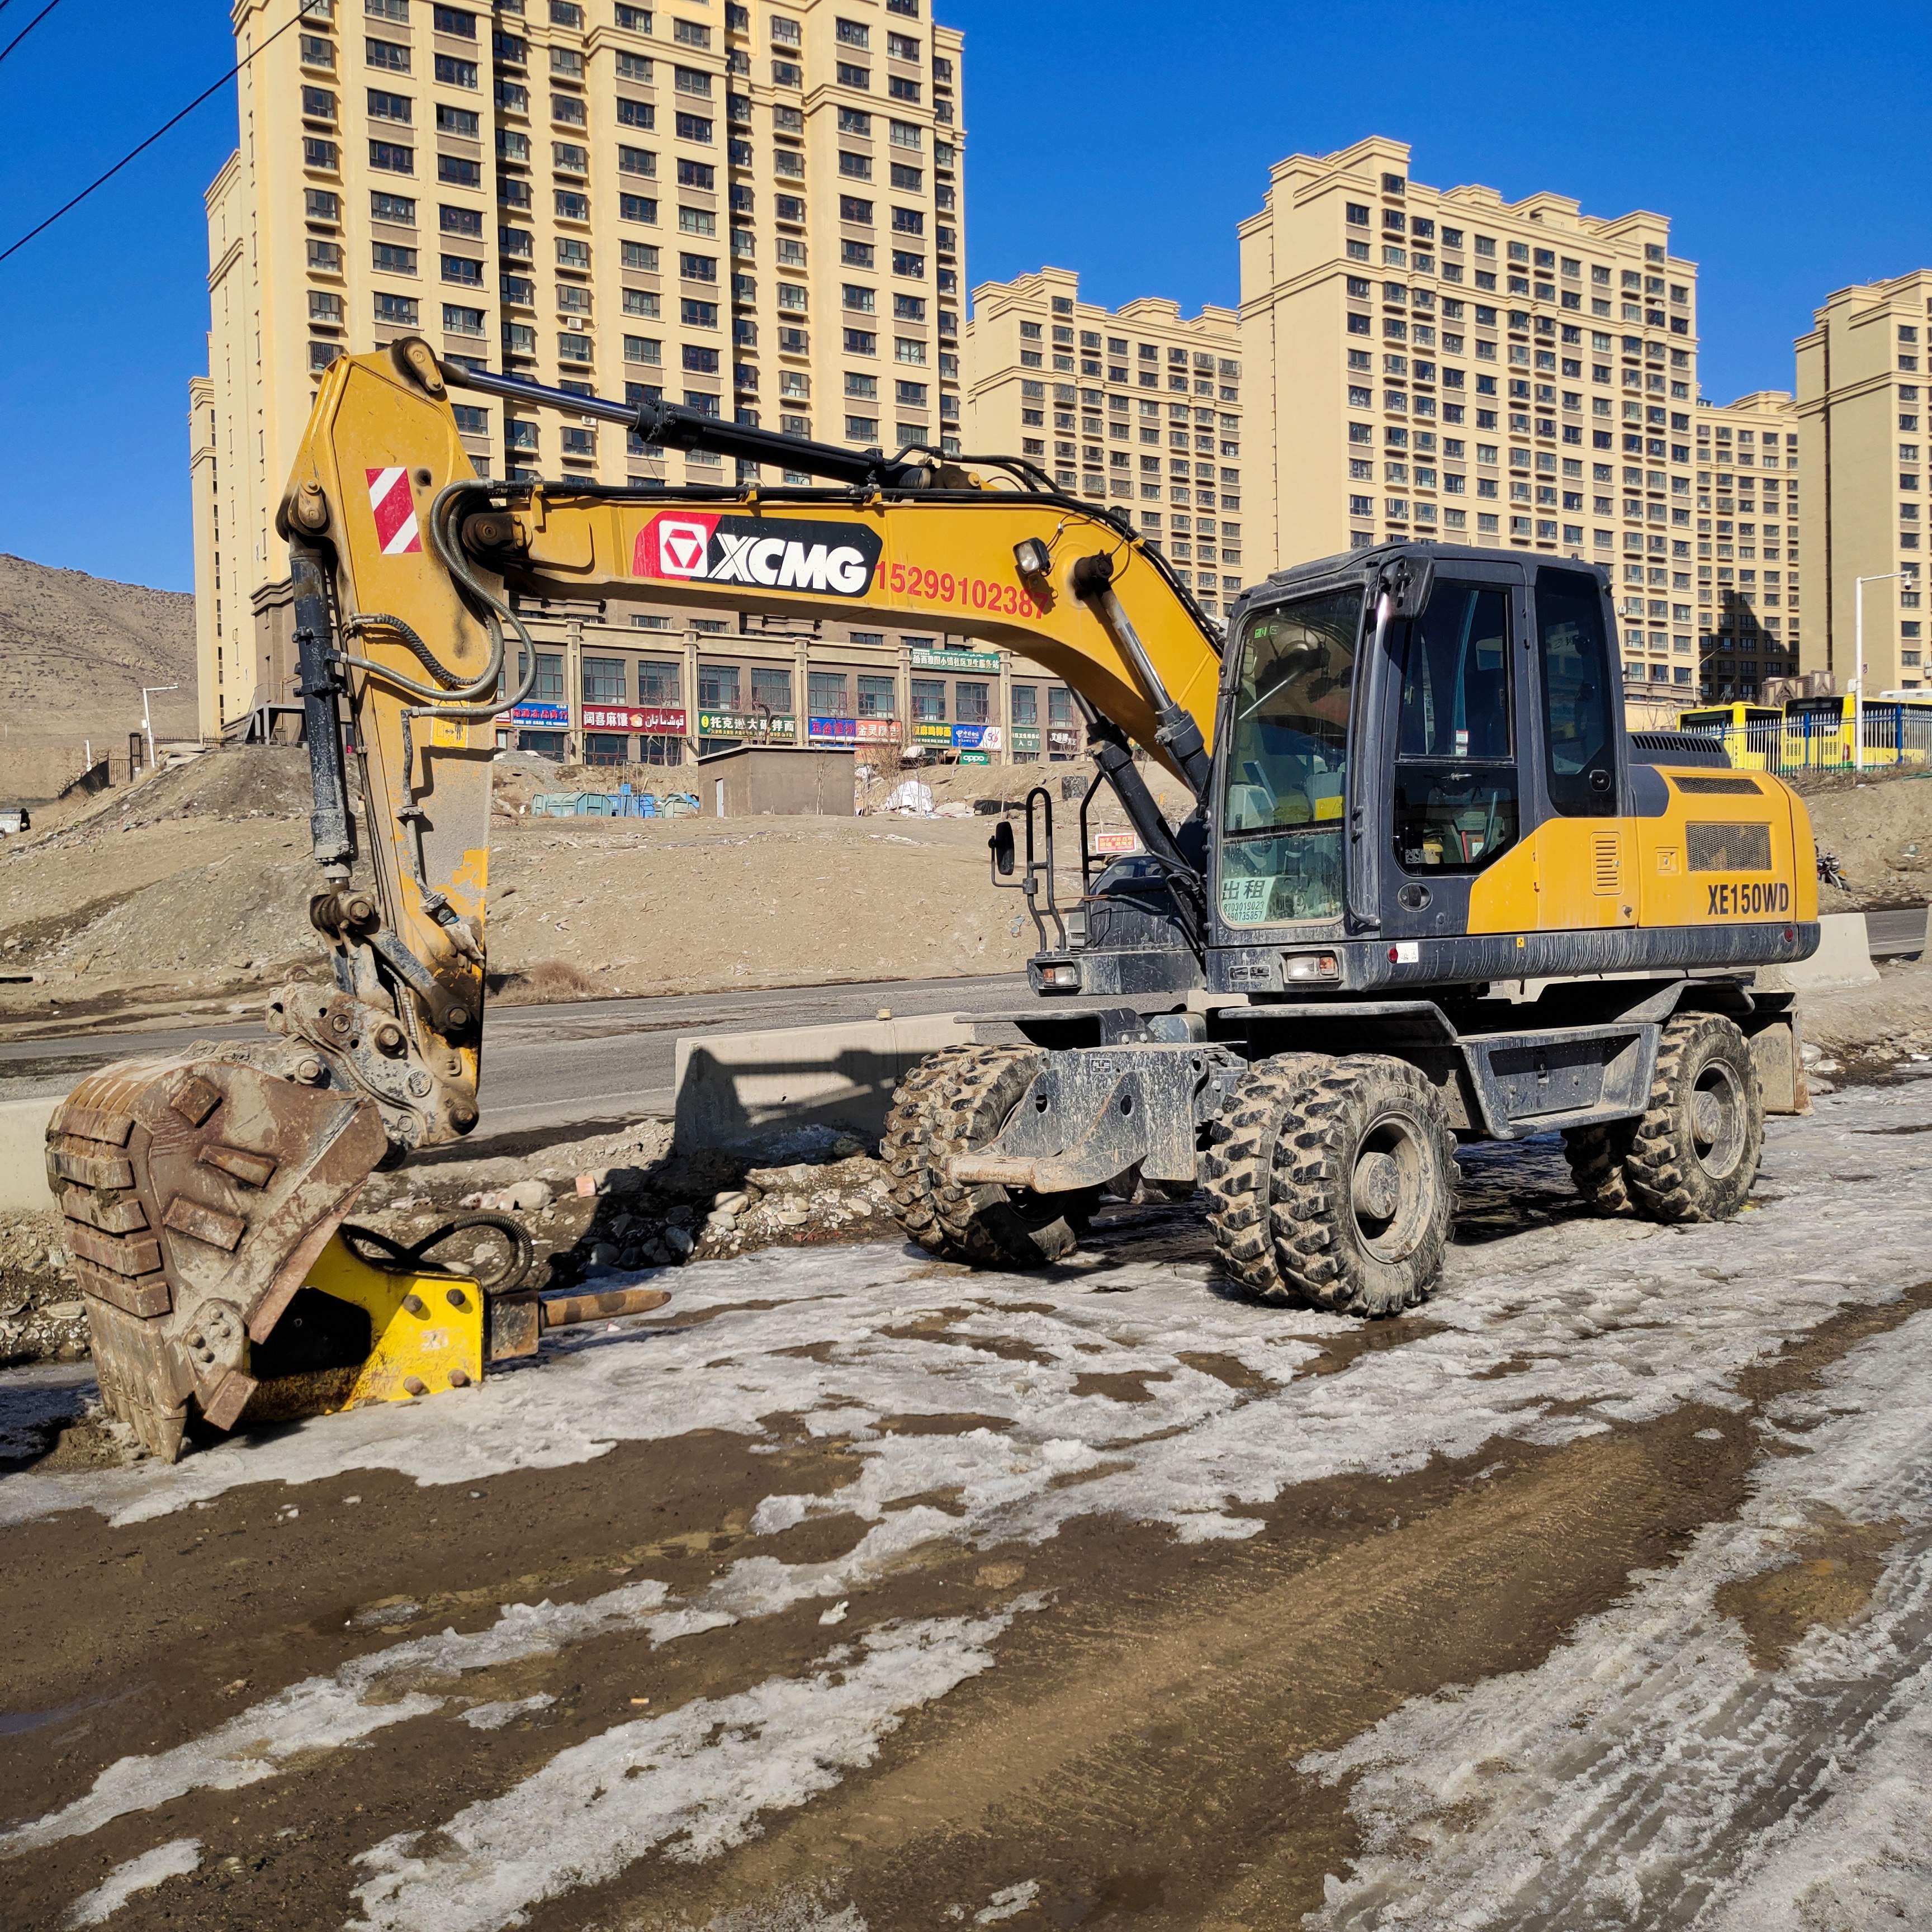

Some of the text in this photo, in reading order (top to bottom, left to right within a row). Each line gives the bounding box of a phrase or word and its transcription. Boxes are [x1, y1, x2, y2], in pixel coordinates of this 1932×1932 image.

[705, 533, 867, 594] XCMG
[875, 561, 1048, 619] 15299102387
[1222, 880, 1266, 900] 出租
[1708, 883, 1789, 915] XE150WD
